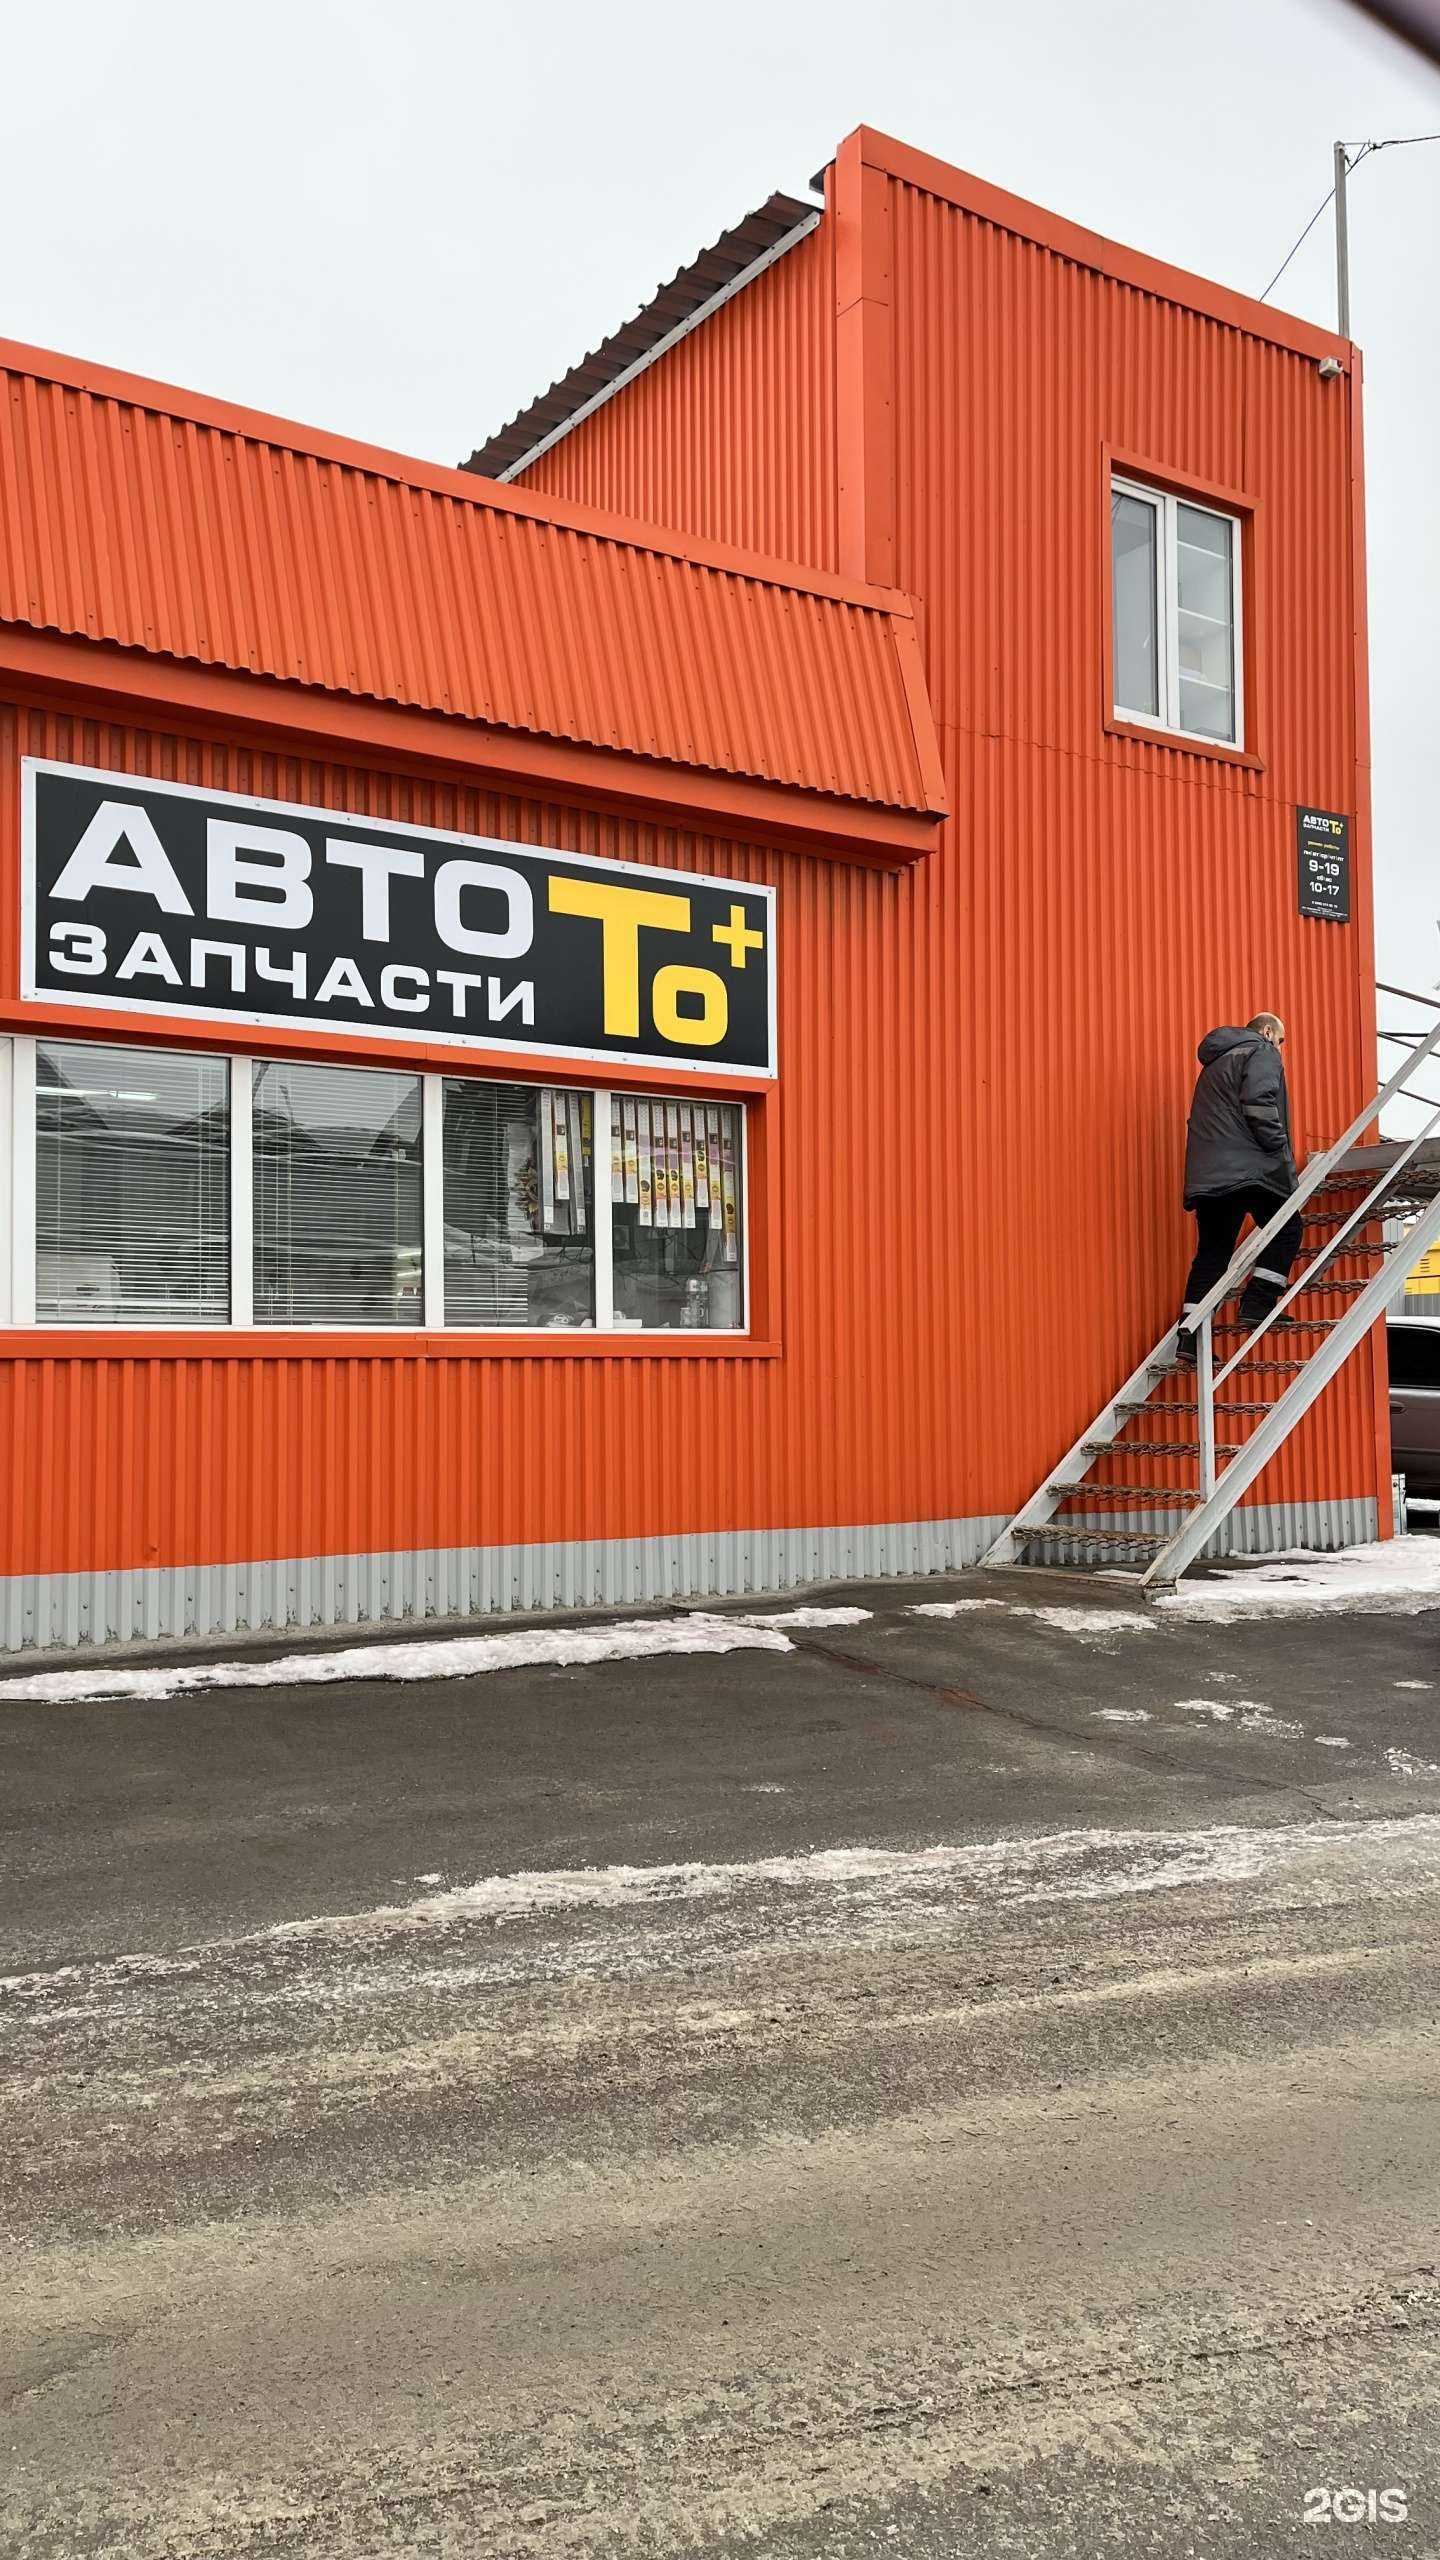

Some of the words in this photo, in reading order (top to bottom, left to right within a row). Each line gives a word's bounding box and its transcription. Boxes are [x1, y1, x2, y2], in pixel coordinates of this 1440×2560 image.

[1303, 814, 1329, 828] АВТО
[1308, 859, 1340, 876] 9-19
[48, 800, 534, 959] АВТО
[1309, 881, 1340, 896] 10-17
[48, 921, 535, 1026] ЗАПЧАСТИ
